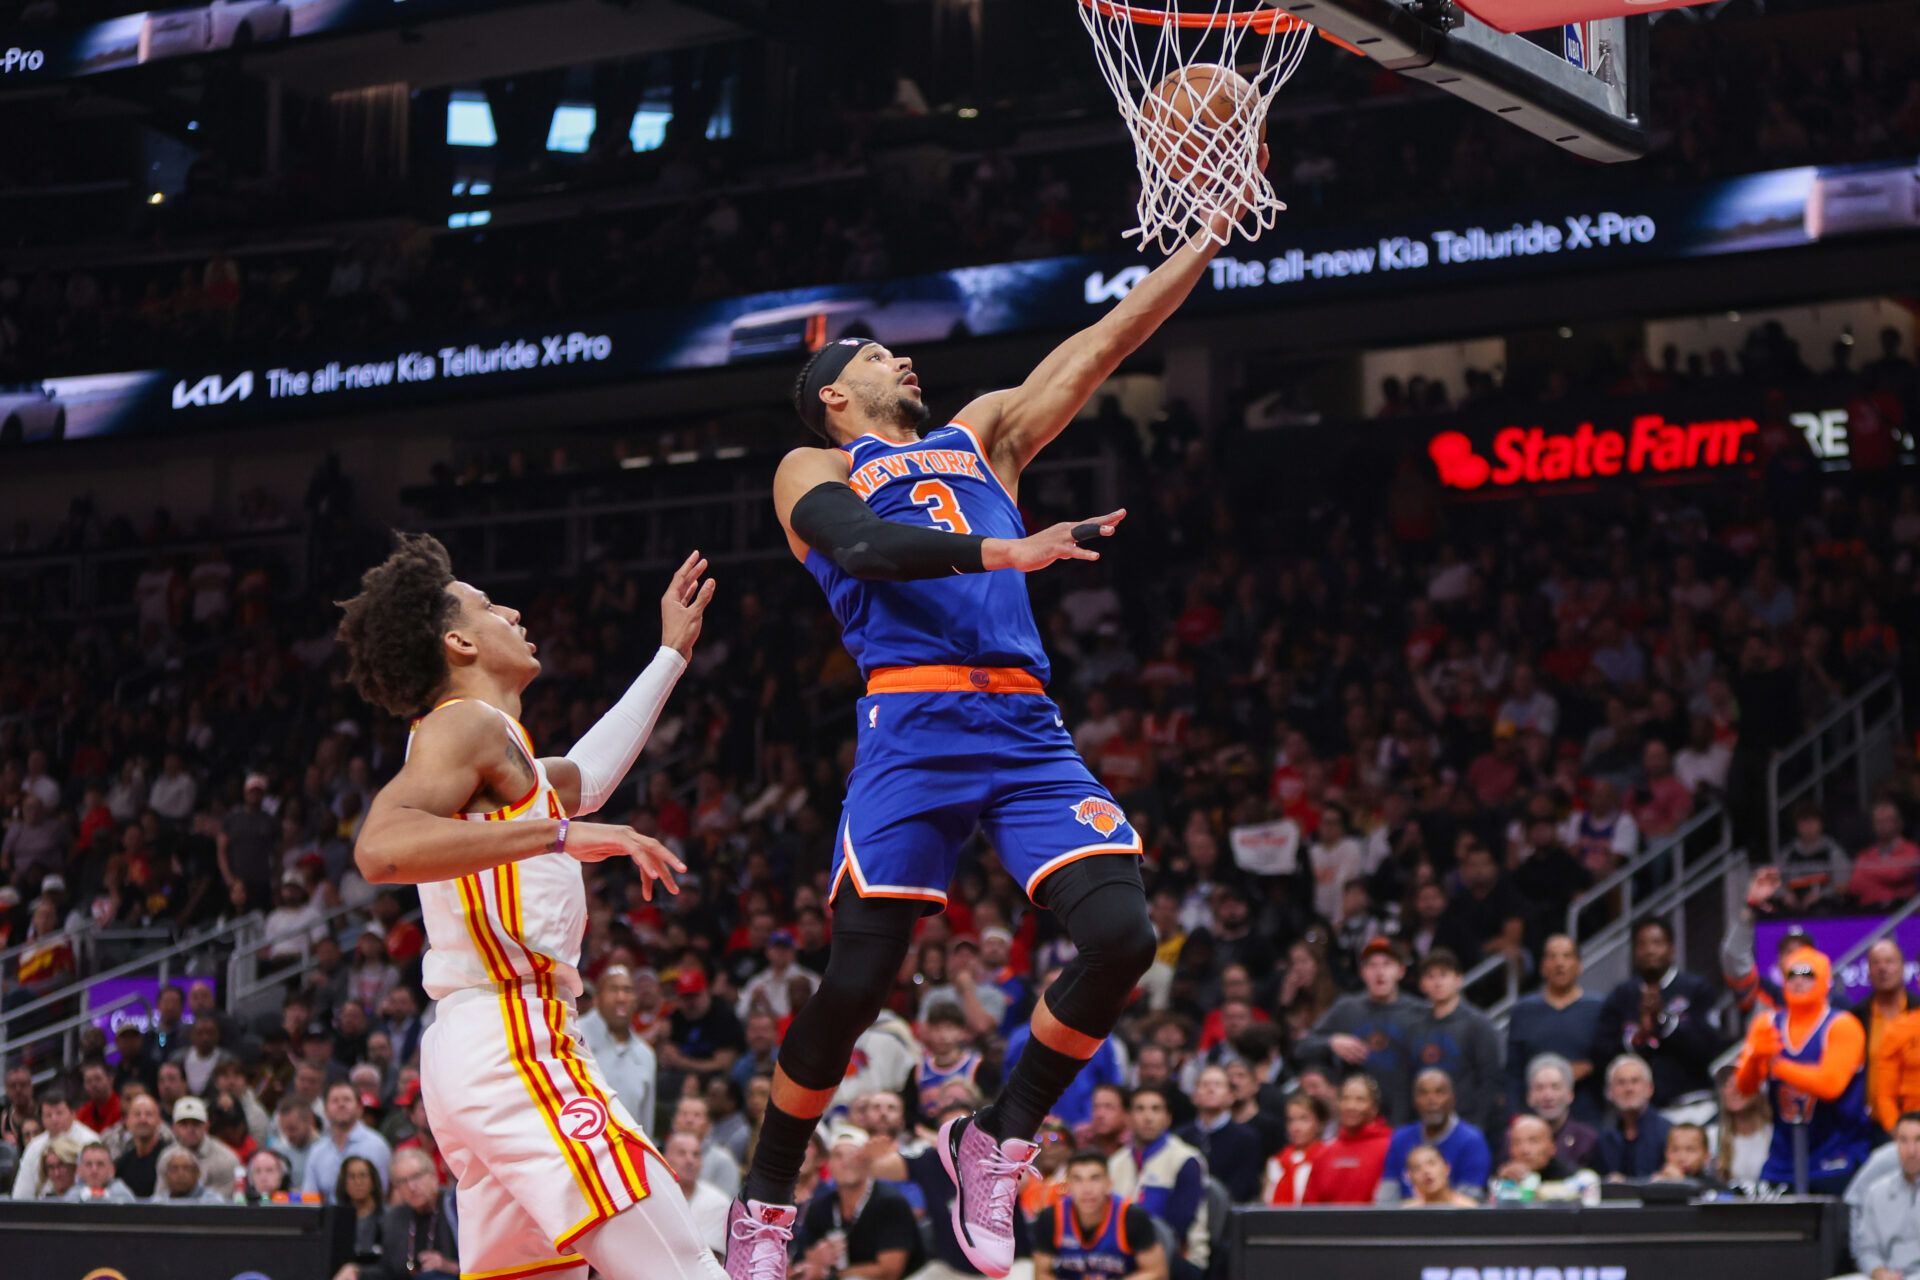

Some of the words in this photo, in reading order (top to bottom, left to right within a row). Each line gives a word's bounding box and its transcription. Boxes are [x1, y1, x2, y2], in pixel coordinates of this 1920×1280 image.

[1208, 256, 1266, 291] The
[1267, 248, 1376, 284] all-new
[1379, 236, 1429, 272] Kia
[1431, 220, 1562, 265] Telluride
[1564, 211, 1656, 250] X-Pro
[265, 368, 310, 398] The
[311, 361, 395, 394] all-new
[397, 351, 436, 383] Kia
[438, 338, 539, 378] Telluride
[541, 332, 612, 366] X-Pro
[849, 452, 911, 502] NEW
[904, 449, 987, 483] YORK
[1491, 421, 1625, 486] State
[1627, 413, 1758, 473] Farm
[909, 478, 972, 535] 3
